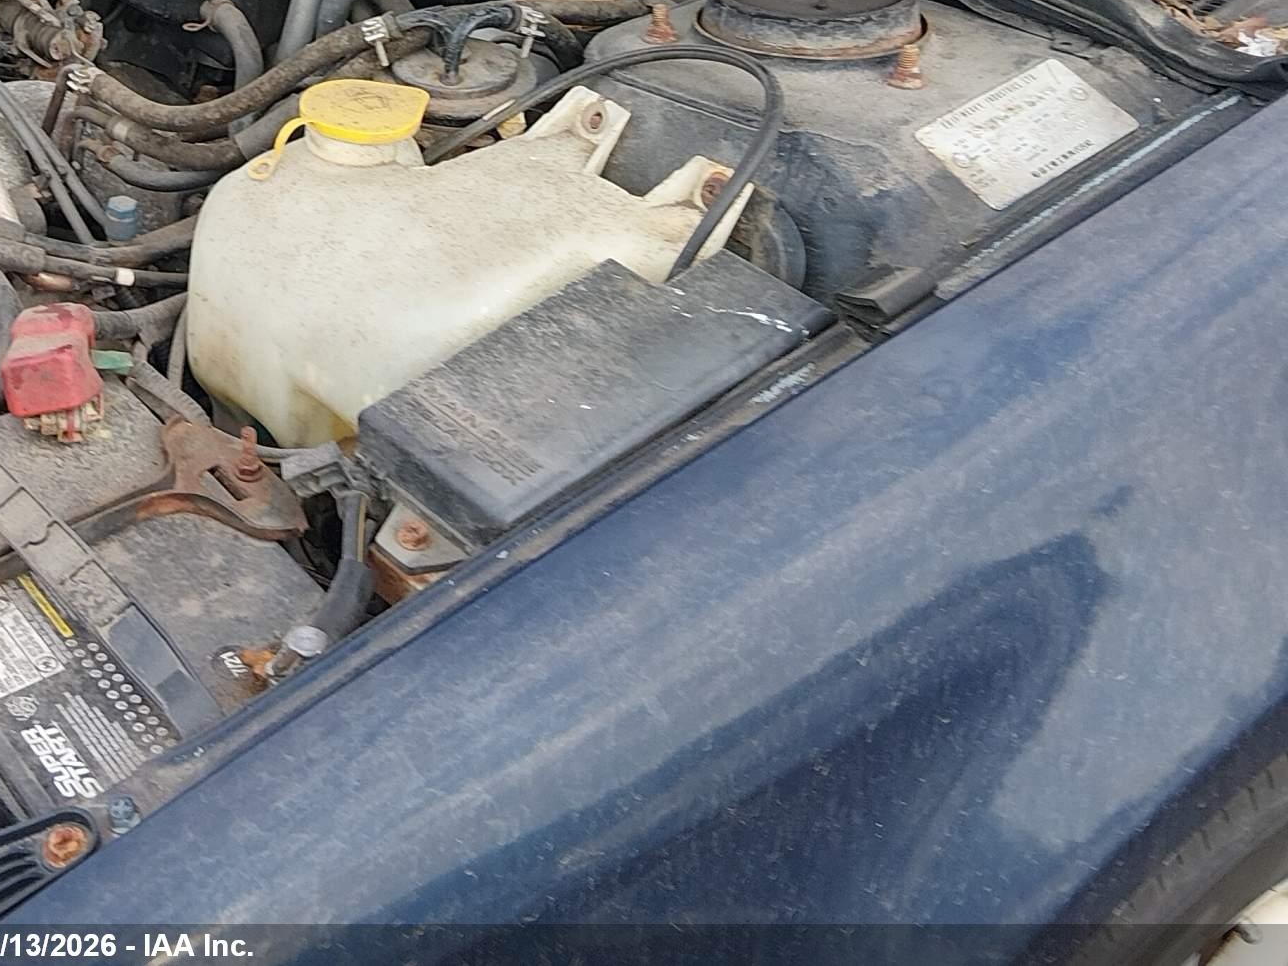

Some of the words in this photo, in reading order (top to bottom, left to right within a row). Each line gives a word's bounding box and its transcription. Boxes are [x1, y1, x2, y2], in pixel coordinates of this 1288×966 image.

[219, 651, 249, 677] 7/21
[20, 727, 76, 798] SUPER
[34, 724, 105, 799] START
